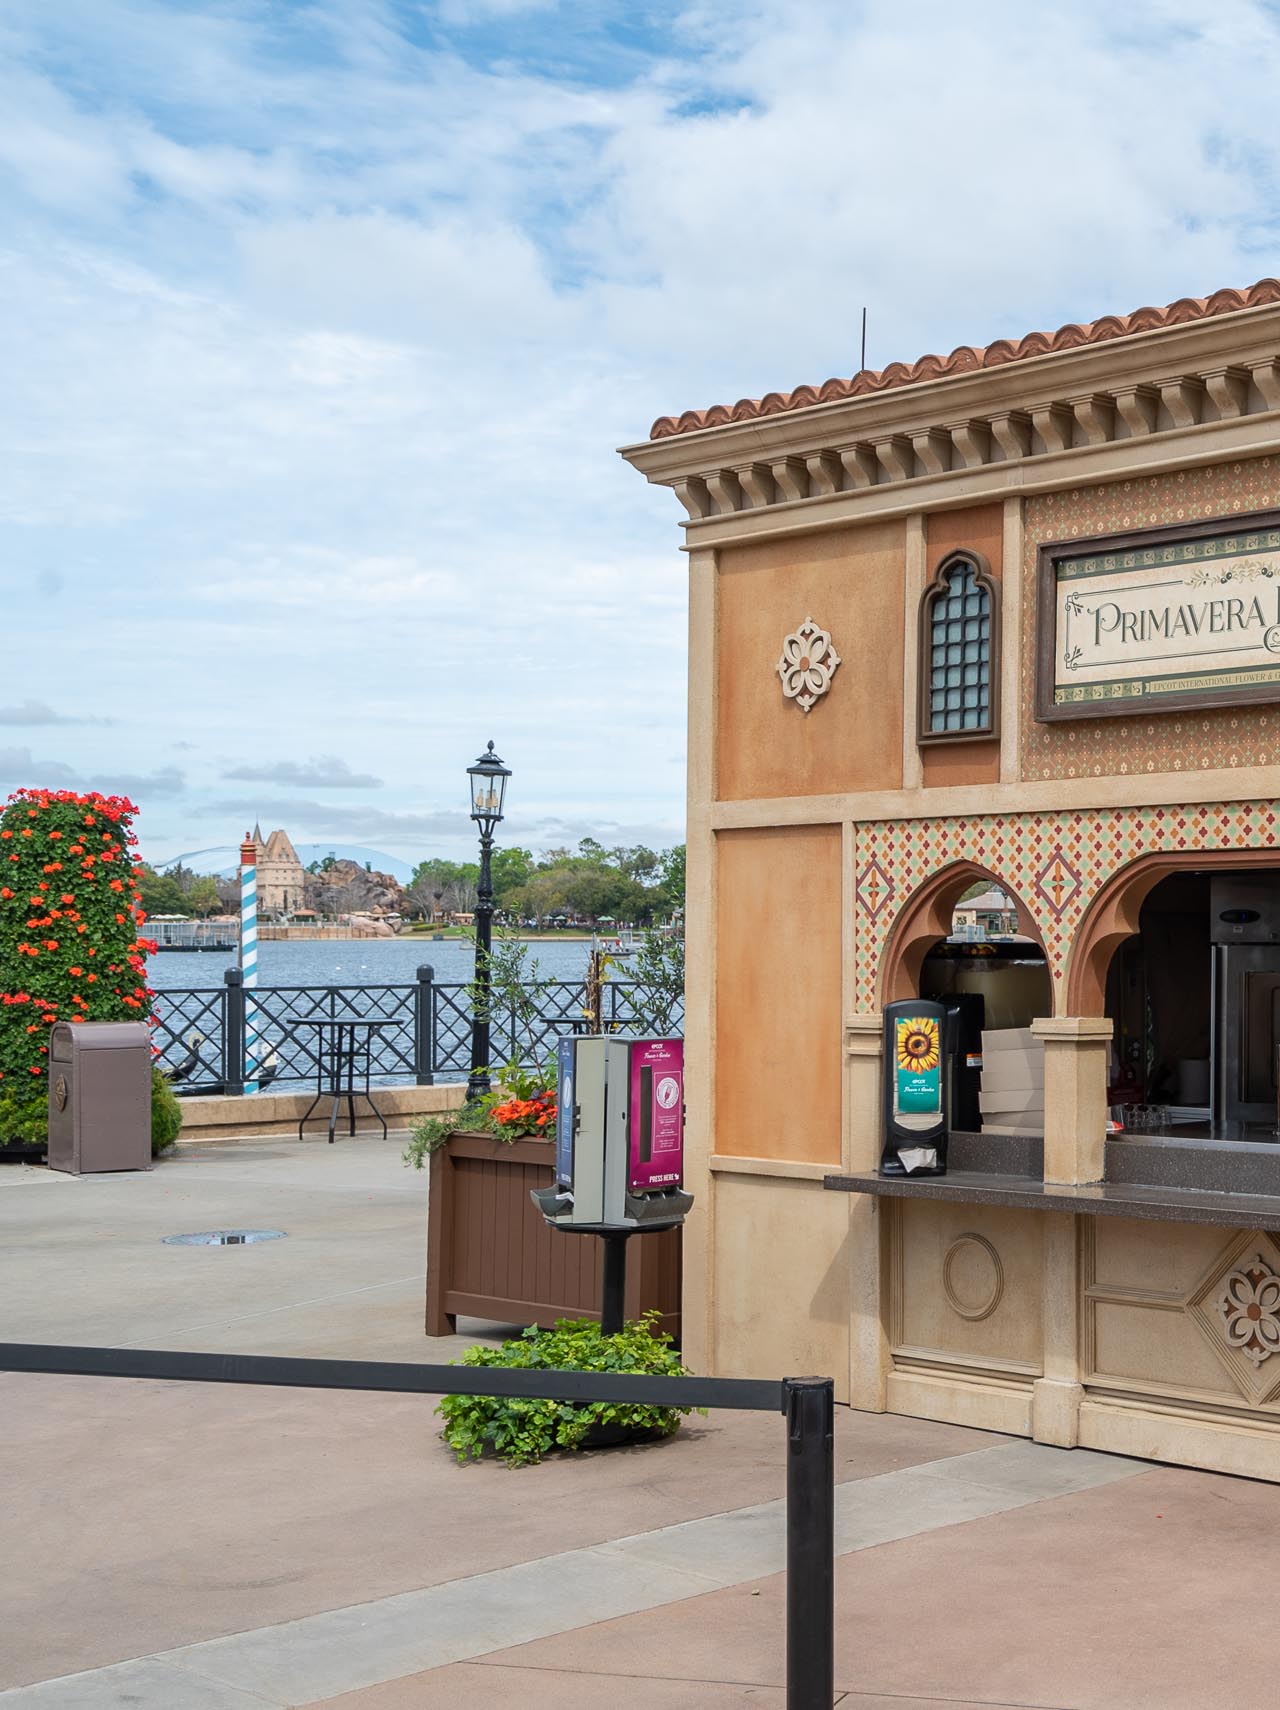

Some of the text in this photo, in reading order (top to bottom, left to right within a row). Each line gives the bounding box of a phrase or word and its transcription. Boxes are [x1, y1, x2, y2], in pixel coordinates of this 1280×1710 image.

[1087, 596, 1267, 646] PRIMAVERA
[1153, 682, 1177, 691] EPCOT
[1178, 676, 1233, 689] INTERNATIONAL
[1235, 672, 1265, 683] FLOWER
[649, 1173, 673, 1183] PRESS HERE
